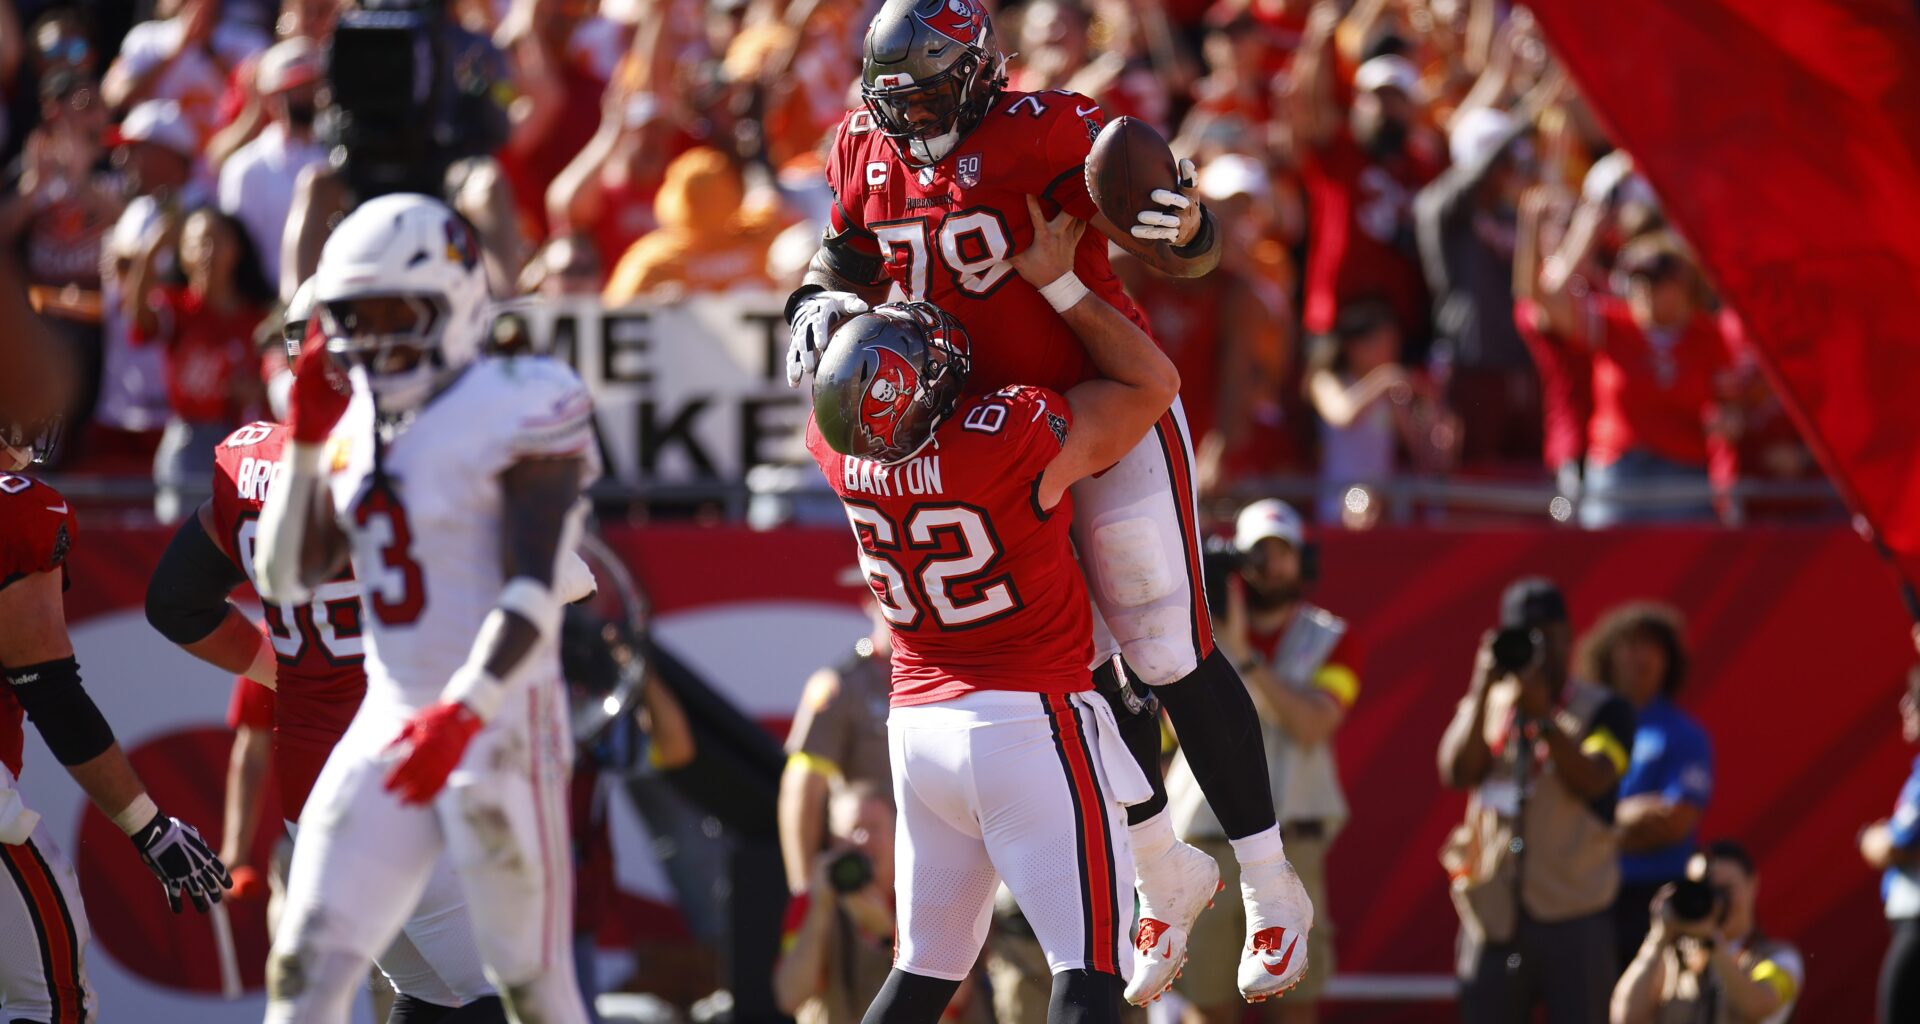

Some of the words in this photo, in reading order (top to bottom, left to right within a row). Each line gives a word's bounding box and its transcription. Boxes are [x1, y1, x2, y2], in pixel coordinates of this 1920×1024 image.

[866, 162, 887, 185] C
[958, 157, 978, 175] 50
[869, 208, 1014, 303] 78
[844, 454, 943, 496] BARTON
[355, 490, 429, 628] 3
[843, 502, 1020, 628] 62
